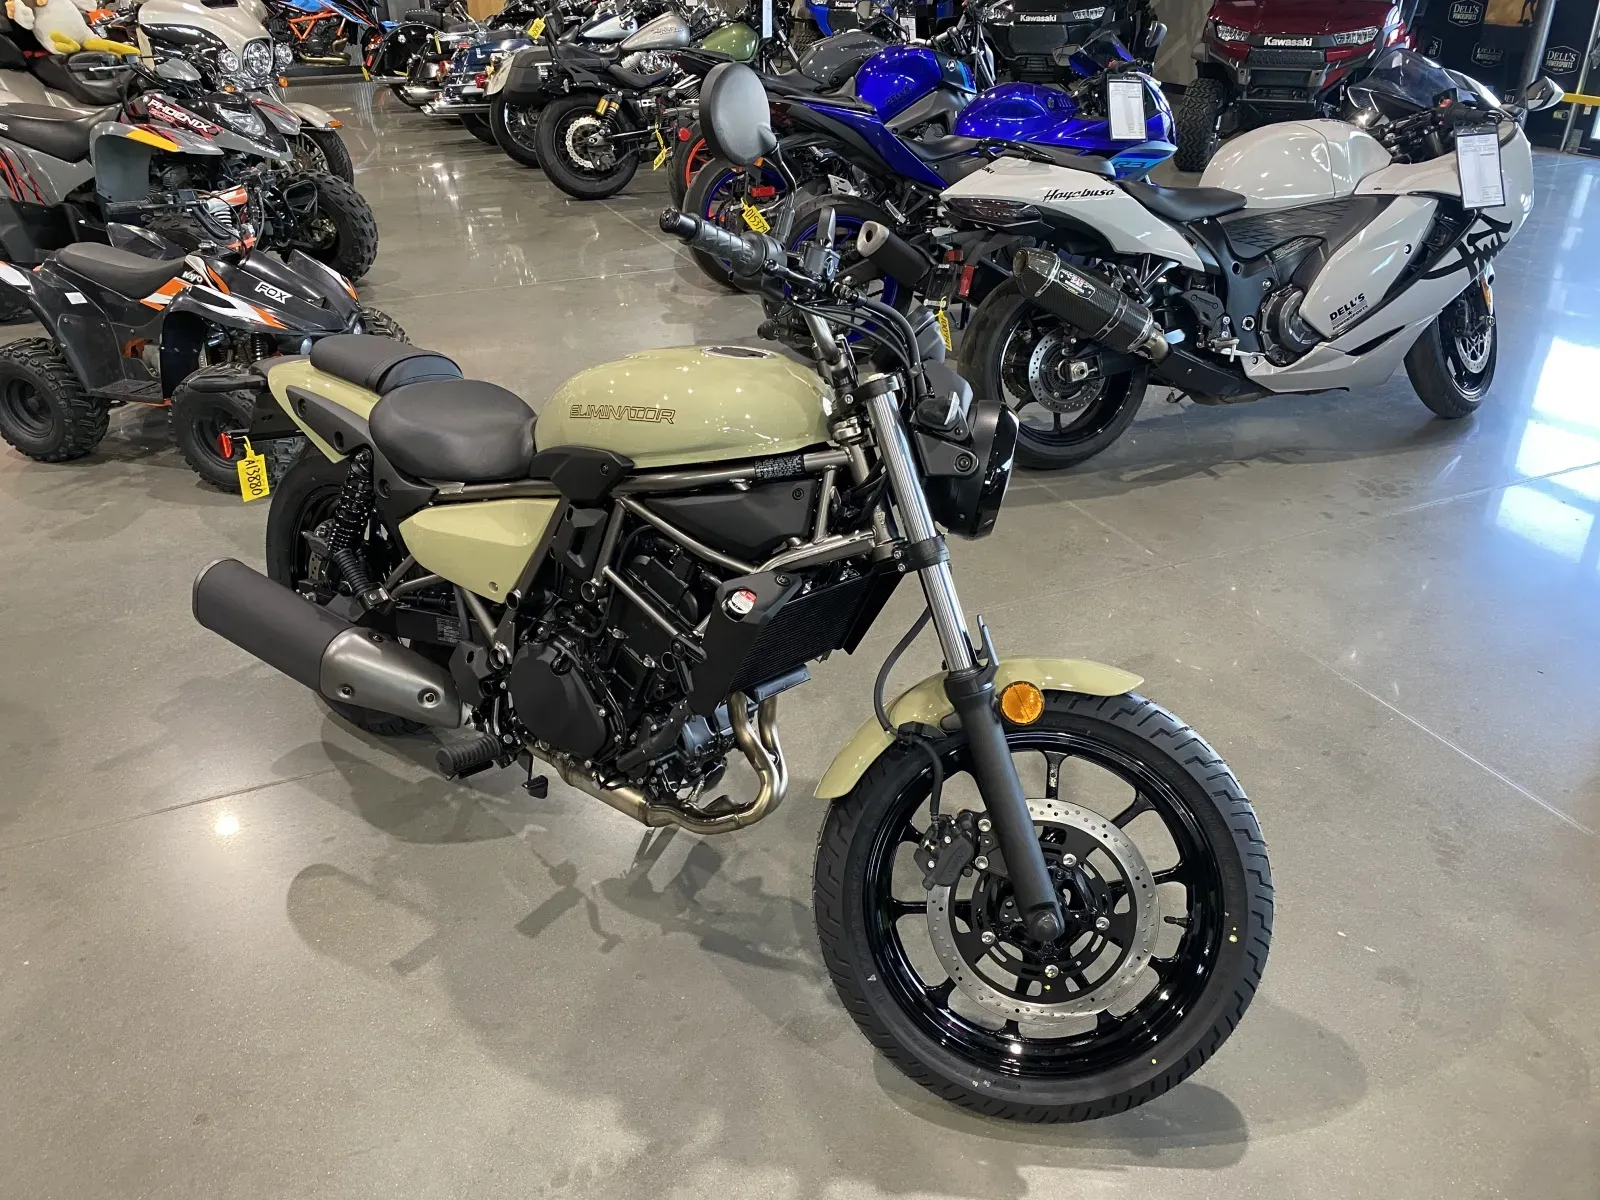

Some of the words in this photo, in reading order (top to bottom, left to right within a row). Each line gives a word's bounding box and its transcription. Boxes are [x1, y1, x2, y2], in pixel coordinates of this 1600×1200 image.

[1453, 4, 1480, 14] DELL'S
[1020, 14, 1057, 22] Kawasaki
[1263, 36, 1313, 47] Kawasaki
[1547, 50, 1577, 63] DELL'S
[147, 98, 212, 133] PHOENIX
[1043, 188, 1116, 203] Hayabusa
[258, 282, 288, 302] FOX
[1329, 292, 1366, 321] DELL'S
[569, 404, 676, 425] ELIMINATOR
